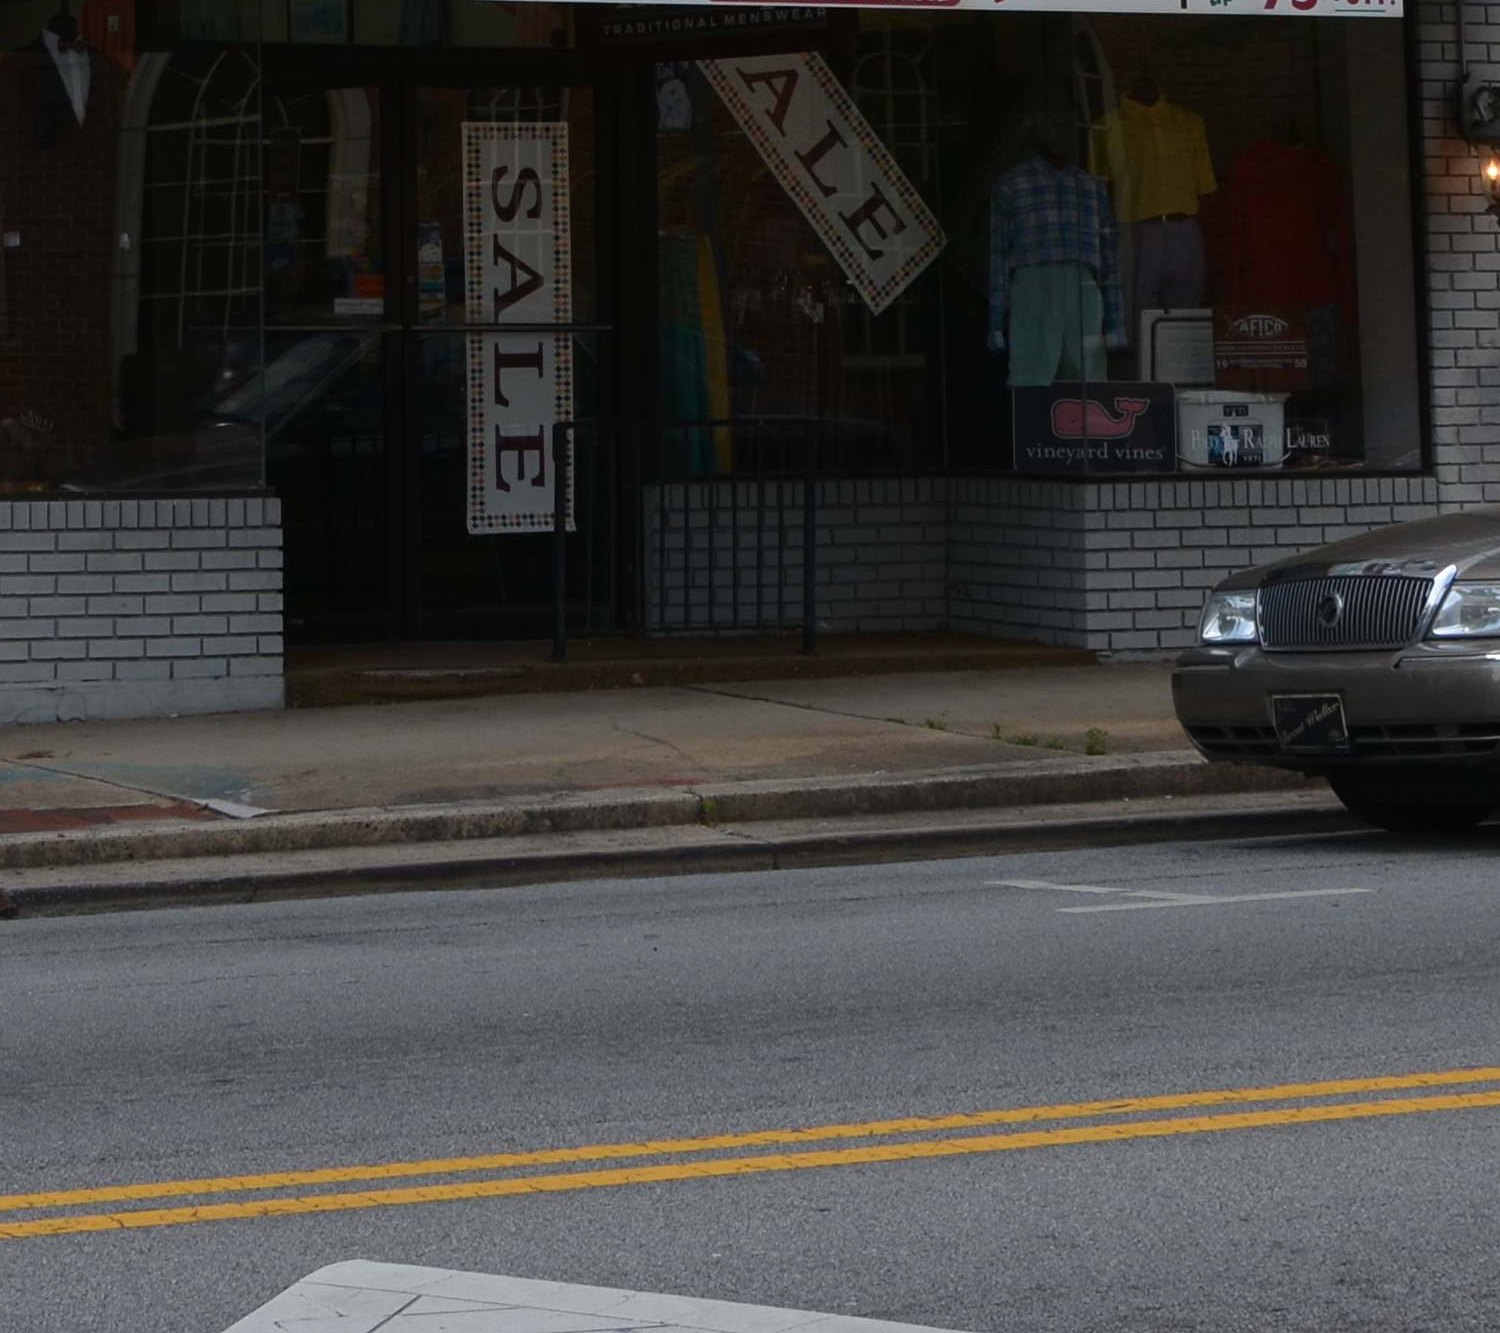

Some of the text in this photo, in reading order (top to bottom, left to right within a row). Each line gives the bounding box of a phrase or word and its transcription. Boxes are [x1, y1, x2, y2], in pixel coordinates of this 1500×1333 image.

[603, 7, 827, 36] TRADITIONAL MENSWEAR
[735, 66, 907, 262] ALE
[490, 165, 546, 494] SALE
[1285, 427, 1330, 449] LAUREN
[1026, 442, 1165, 465] vineyard vines
